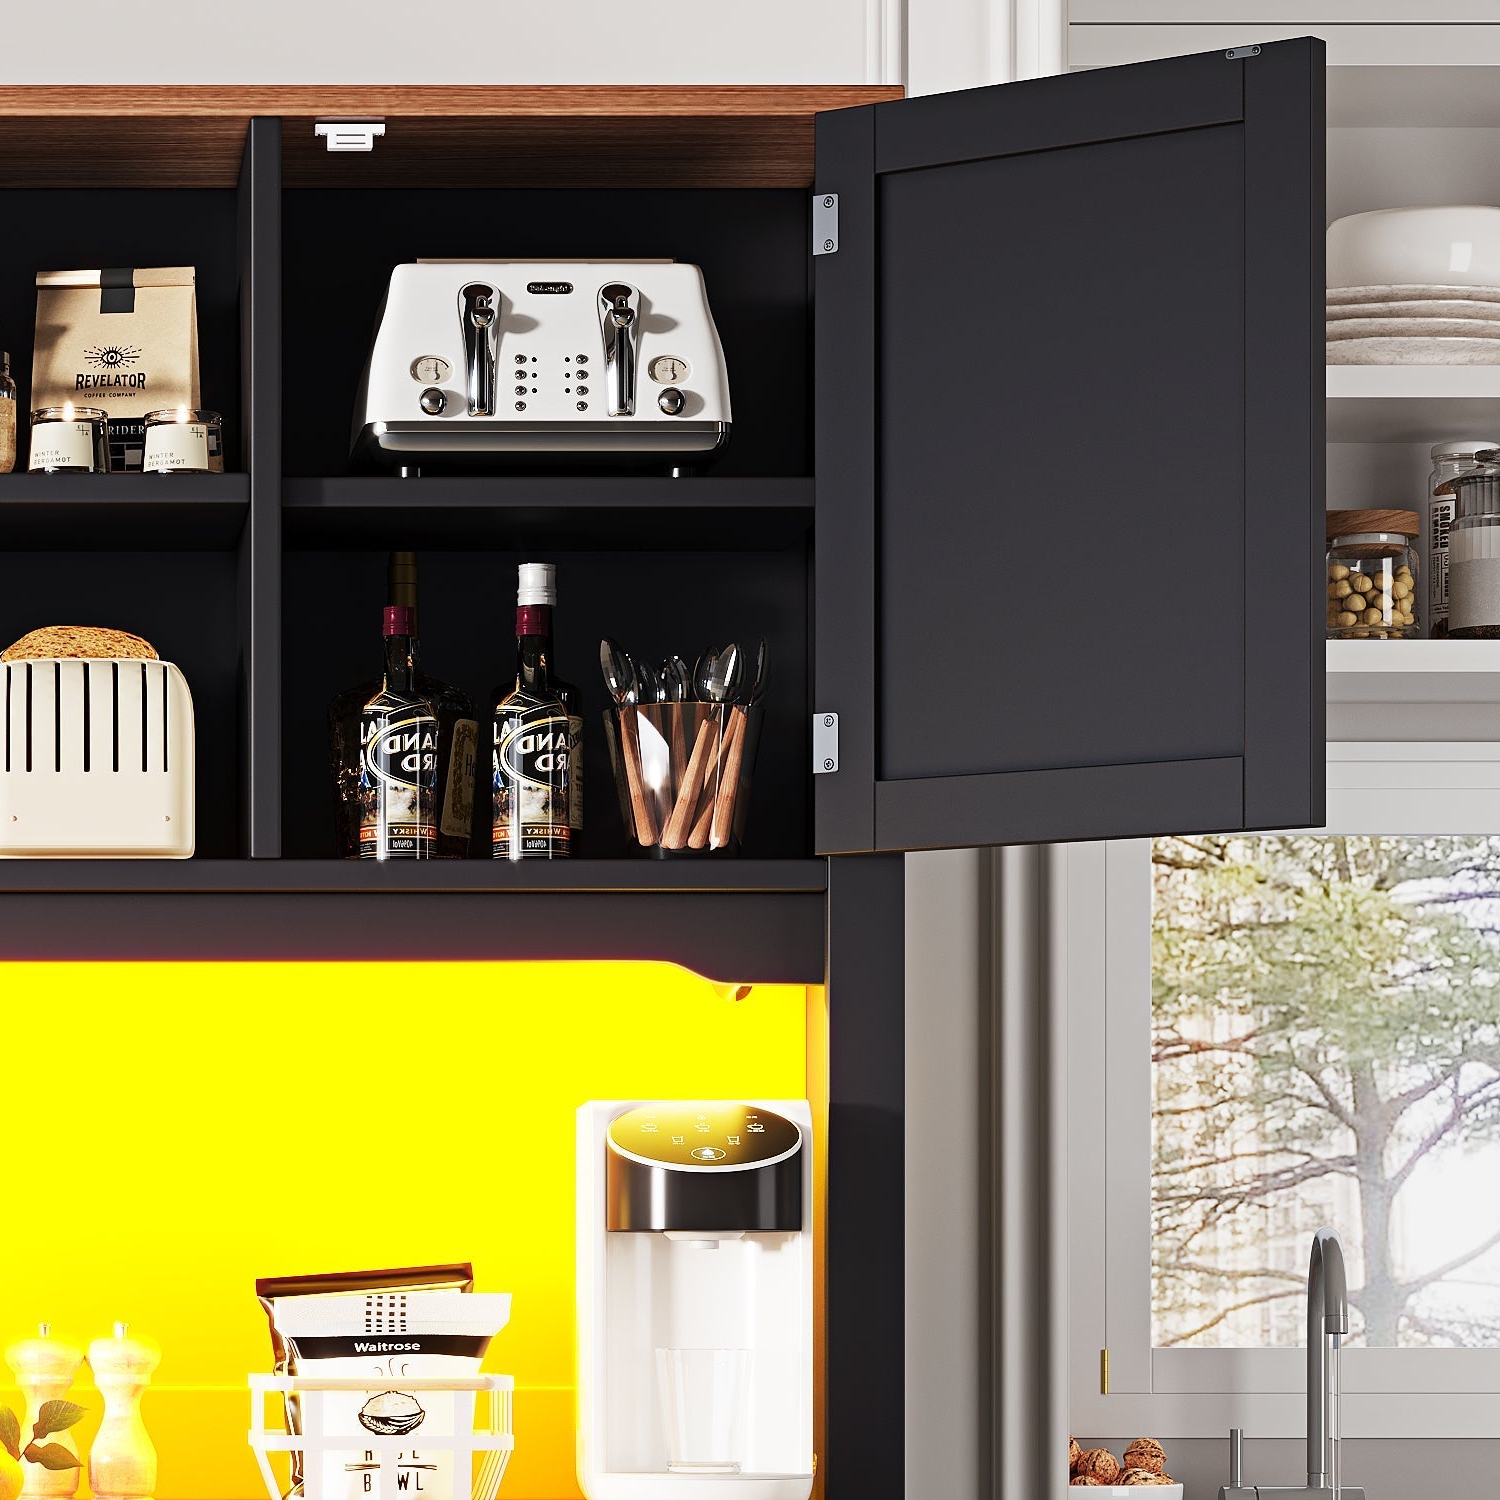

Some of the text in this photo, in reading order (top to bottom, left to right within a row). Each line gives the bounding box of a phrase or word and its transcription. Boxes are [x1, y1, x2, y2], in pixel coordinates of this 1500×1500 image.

[75, 373, 146, 390] REVELATOR
[34, 457, 71, 465] BERGAMOT
[149, 452, 174, 460] WINTER
[148, 459, 185, 467] BERGAMOT
[1440, 505, 1450, 548] SMOKED
[354, 1342, 421, 1353] Waitrose
[363, 1471, 424, 1492] BWL
